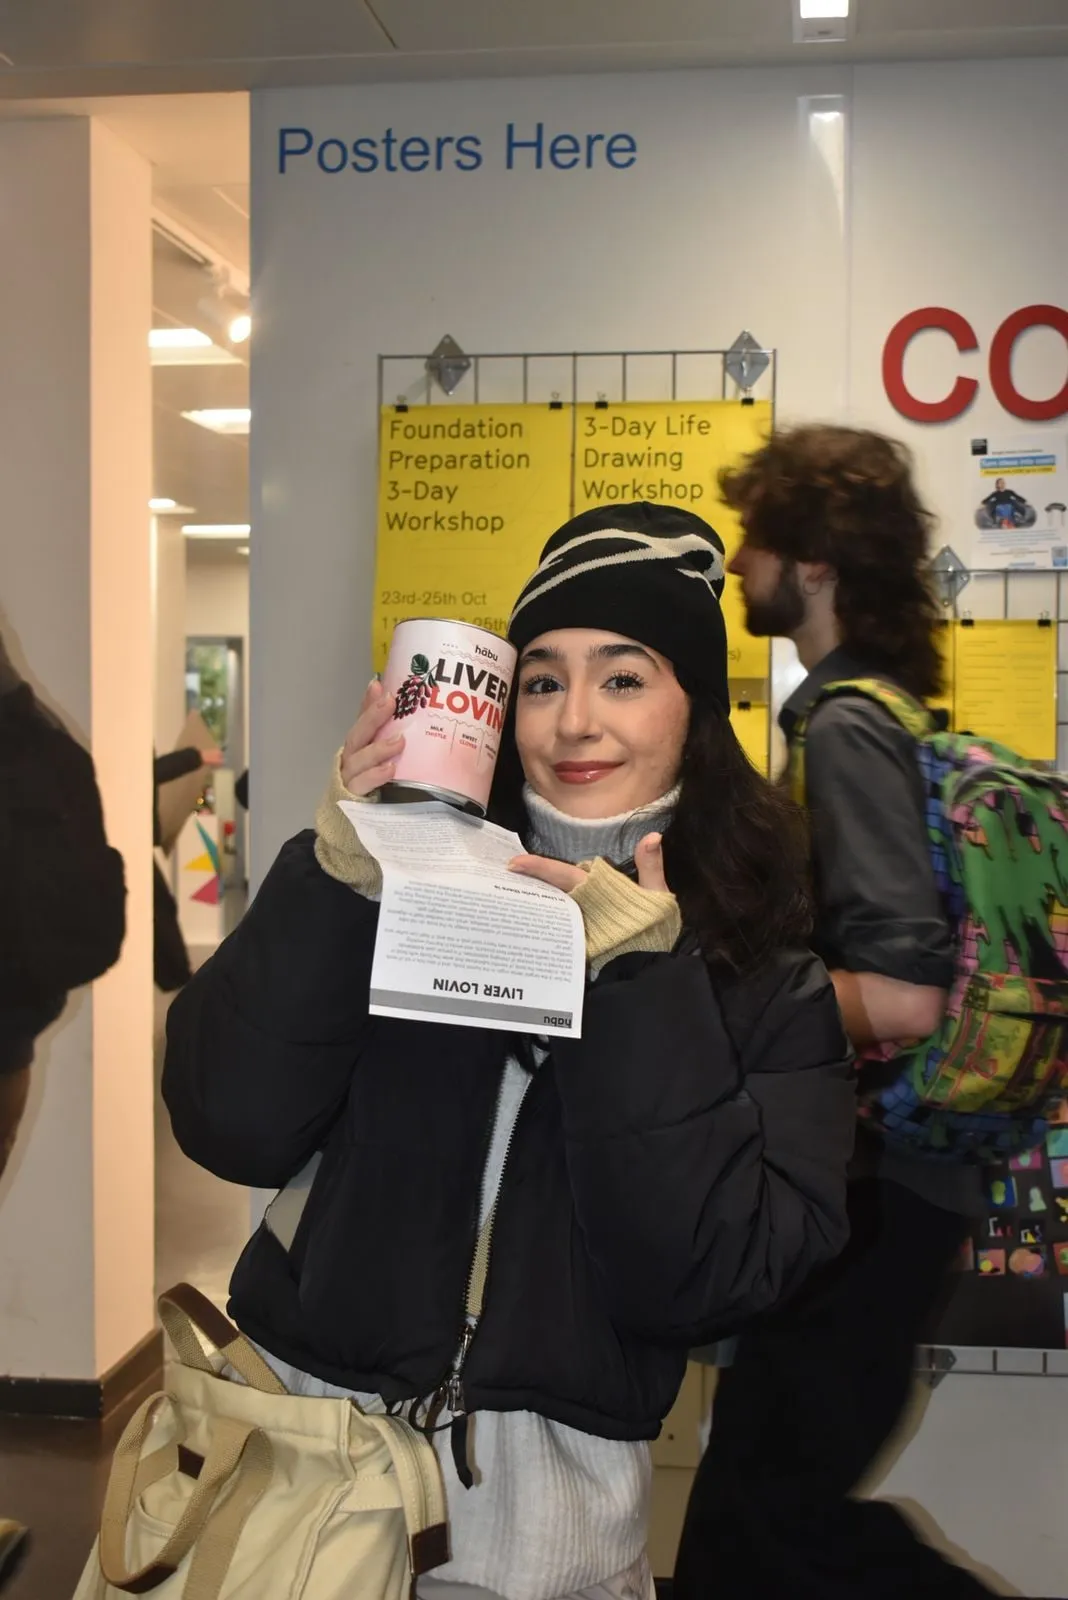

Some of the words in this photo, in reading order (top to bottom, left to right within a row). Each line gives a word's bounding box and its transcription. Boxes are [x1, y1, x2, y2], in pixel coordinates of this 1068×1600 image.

[278, 127, 483, 174] Posters
[505, 122, 637, 170] Here
[389, 417, 523, 440] Foundation
[584, 415, 657, 440] 3-Day
[666, 414, 712, 436] Life
[388, 448, 530, 473] Preparation
[584, 446, 683, 472] Drawing
[386, 480, 459, 504] 3-Day
[582, 478, 704, 503] Workshop
[385, 510, 505, 535] Workshop
[381, 590, 457, 606] 23rd-25th
[461, 590, 488, 606] Oct
[435, 658, 508, 708] LIVER
[428, 686, 505, 735] LOVIN
[432, 977, 479, 995] LOVIN
[483, 984, 524, 1000] LIVER
